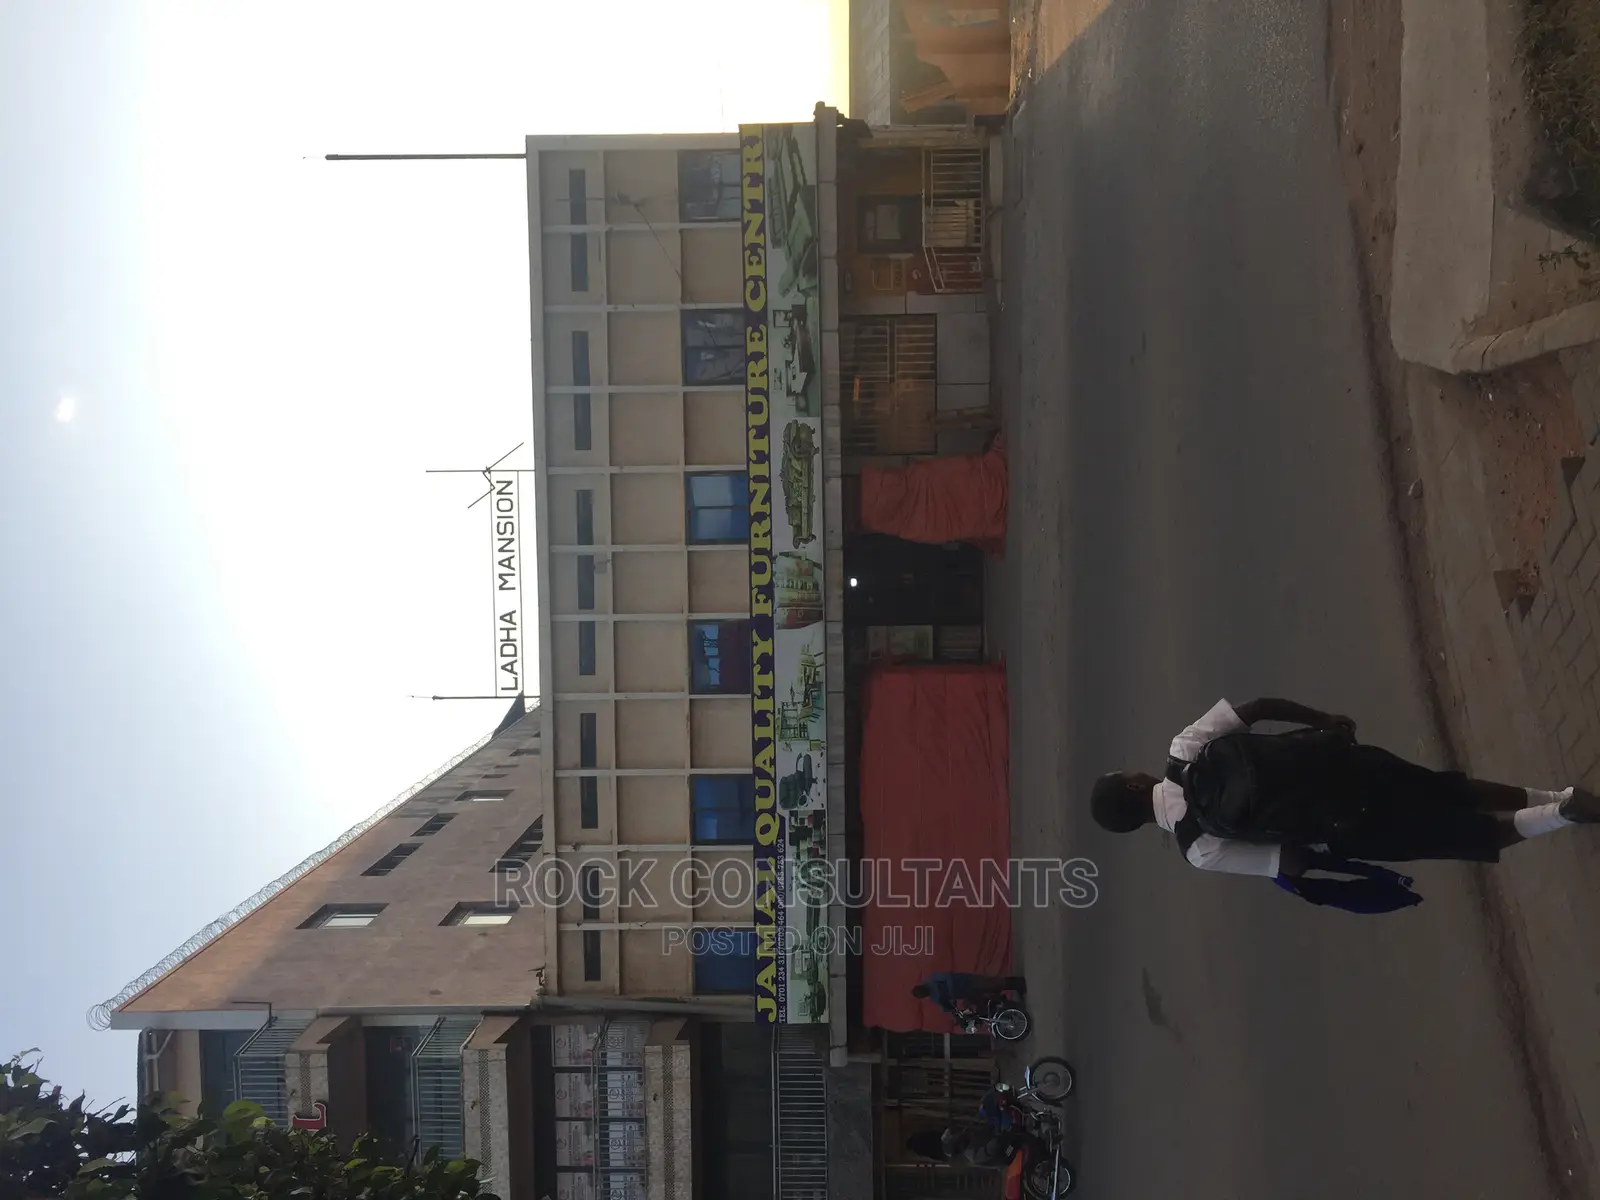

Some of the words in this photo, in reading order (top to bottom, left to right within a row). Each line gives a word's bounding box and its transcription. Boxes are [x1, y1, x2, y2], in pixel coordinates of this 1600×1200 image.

[745, 324, 772, 616] FURNITURE
[496, 480, 516, 591] MANSION
[500, 610, 518, 691] LADHA
[752, 629, 779, 846] QUALITY
[755, 856, 777, 1022] JAMAL
[778, 967, 786, 982] 234
[778, 984, 786, 1002] 0701
[778, 1006, 786, 1023] TEL:
